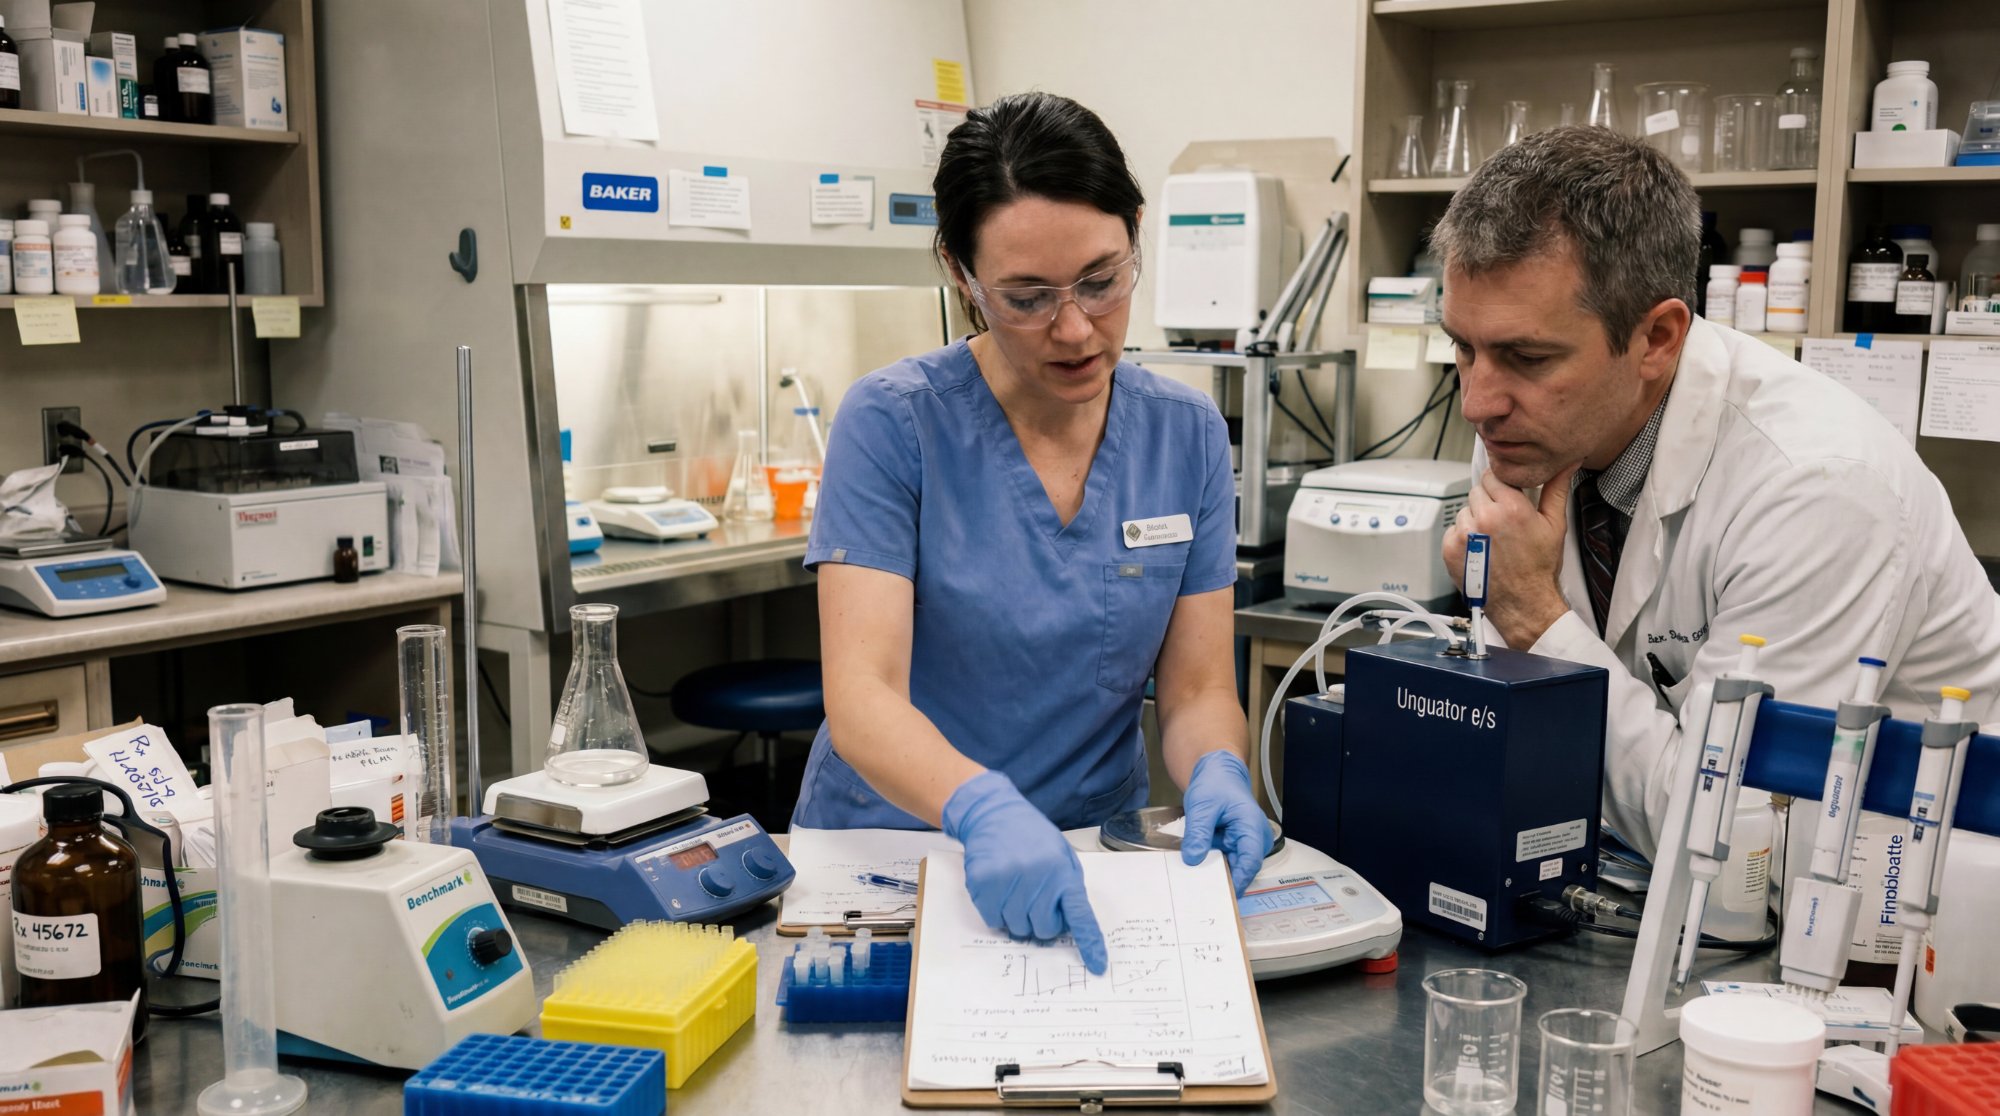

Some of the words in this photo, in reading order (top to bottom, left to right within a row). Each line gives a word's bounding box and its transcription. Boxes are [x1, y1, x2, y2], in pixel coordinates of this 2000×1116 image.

[589, 184, 652, 202] BAKER
[1397, 686, 1467, 722] Unguator
[1471, 705, 1496, 728] e/s
[406, 874, 464, 911] Benchmark
[32, 922, 89, 940] 45672
